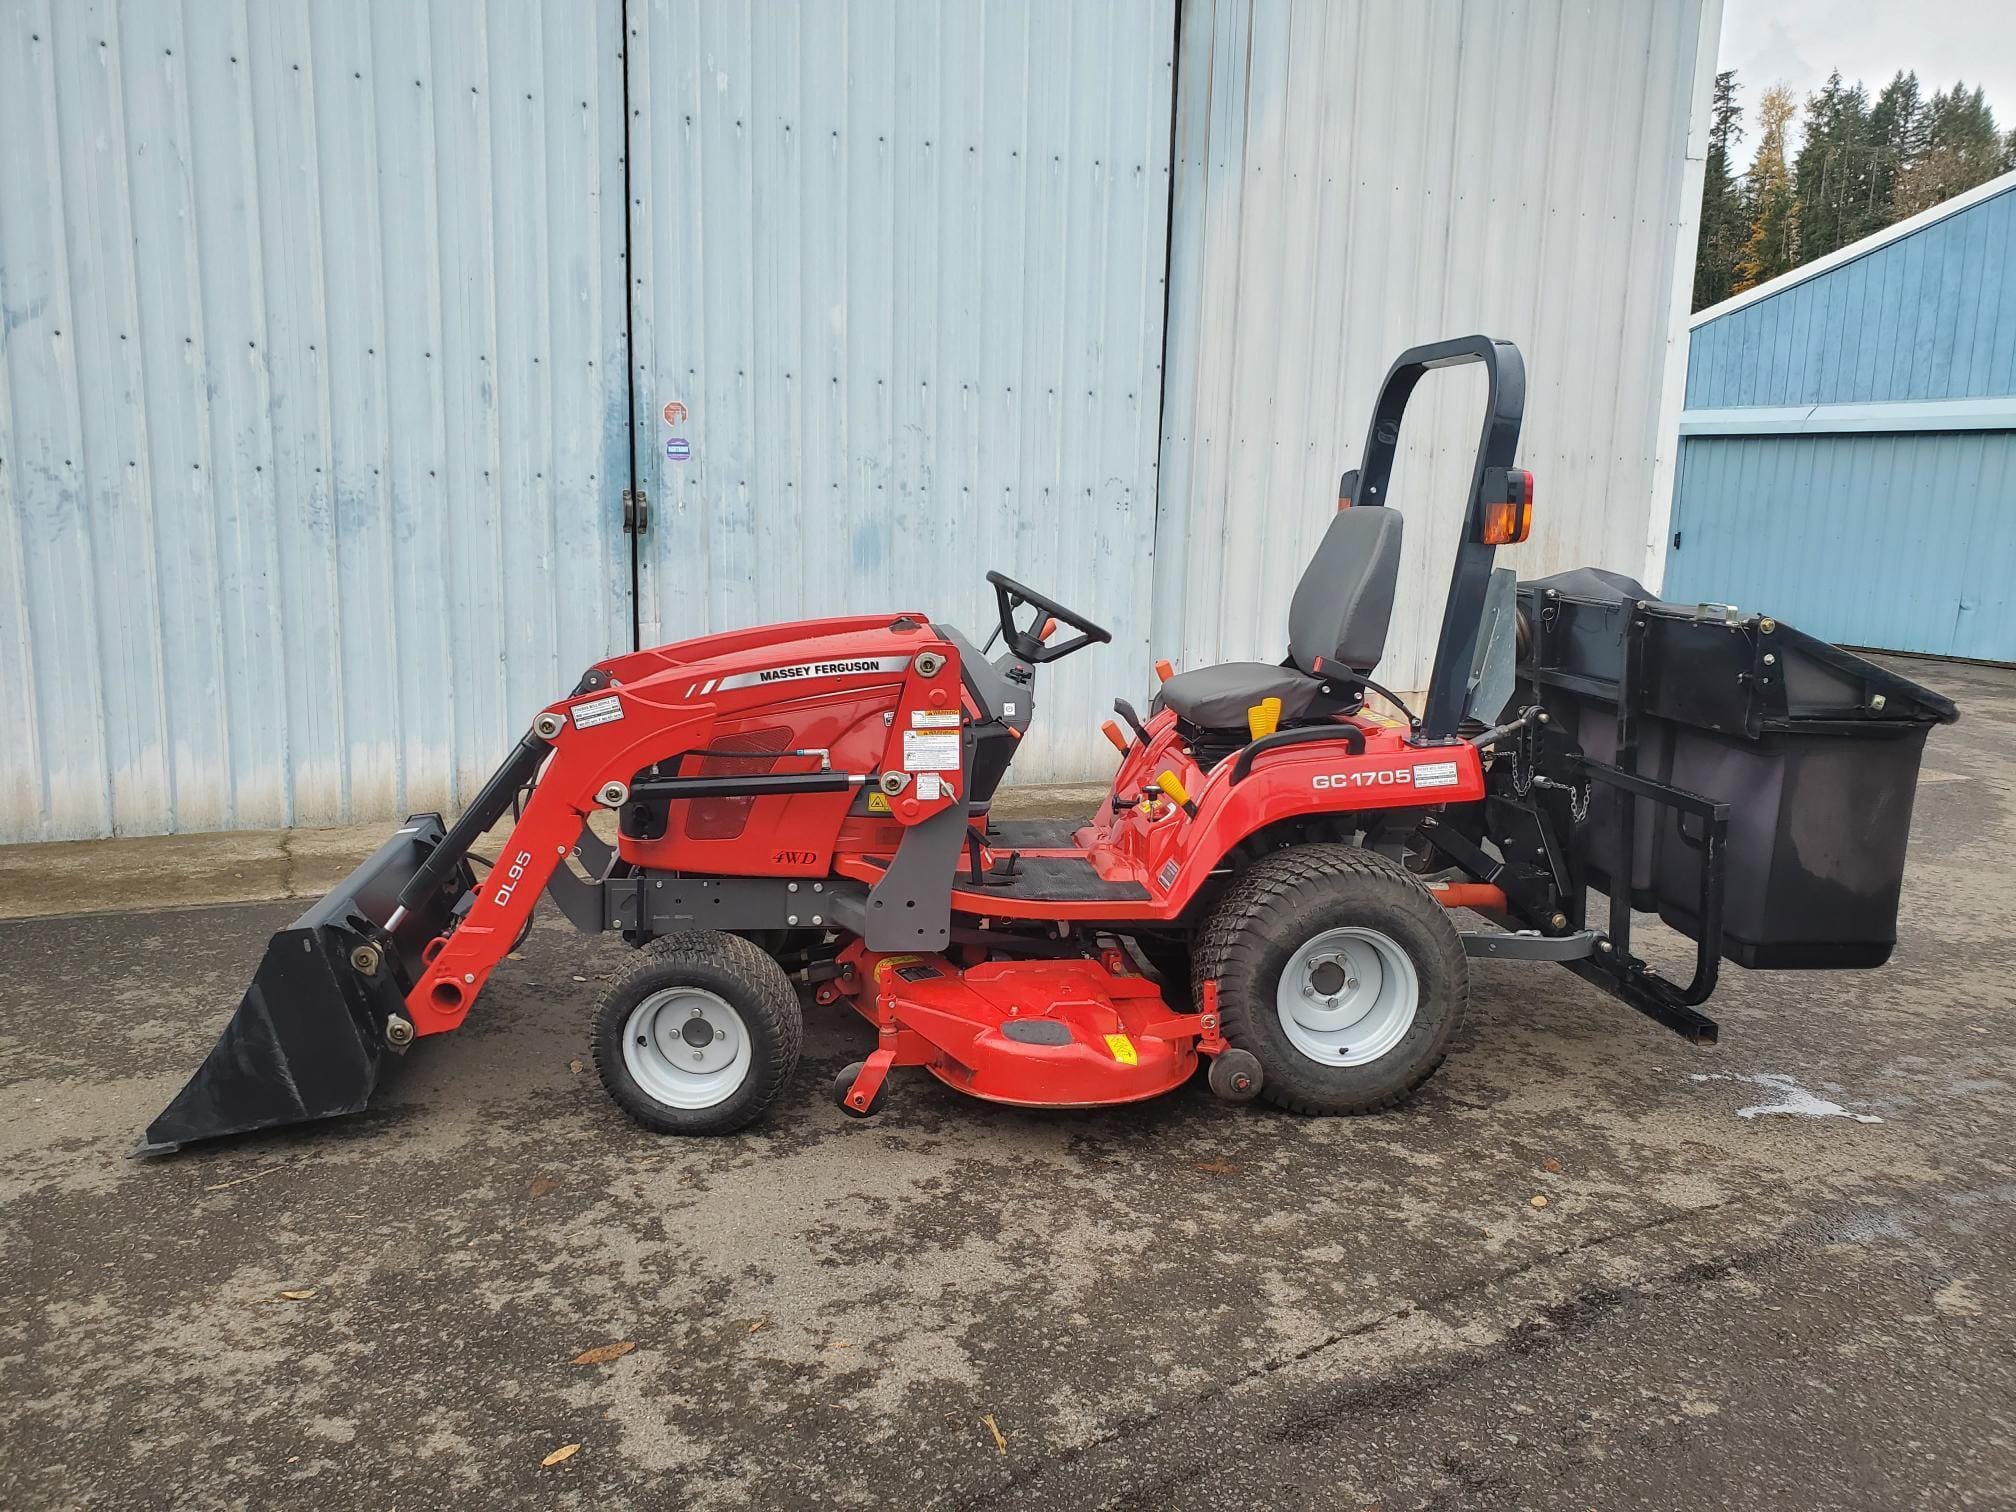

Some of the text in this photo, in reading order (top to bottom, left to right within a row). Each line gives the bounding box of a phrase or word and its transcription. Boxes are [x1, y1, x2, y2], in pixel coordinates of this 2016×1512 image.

[760, 661, 880, 681] MASSEY FERGUSON
[1312, 769, 1411, 789] GC 1705
[771, 850, 817, 865] 4WD
[494, 850, 531, 907] DL95
